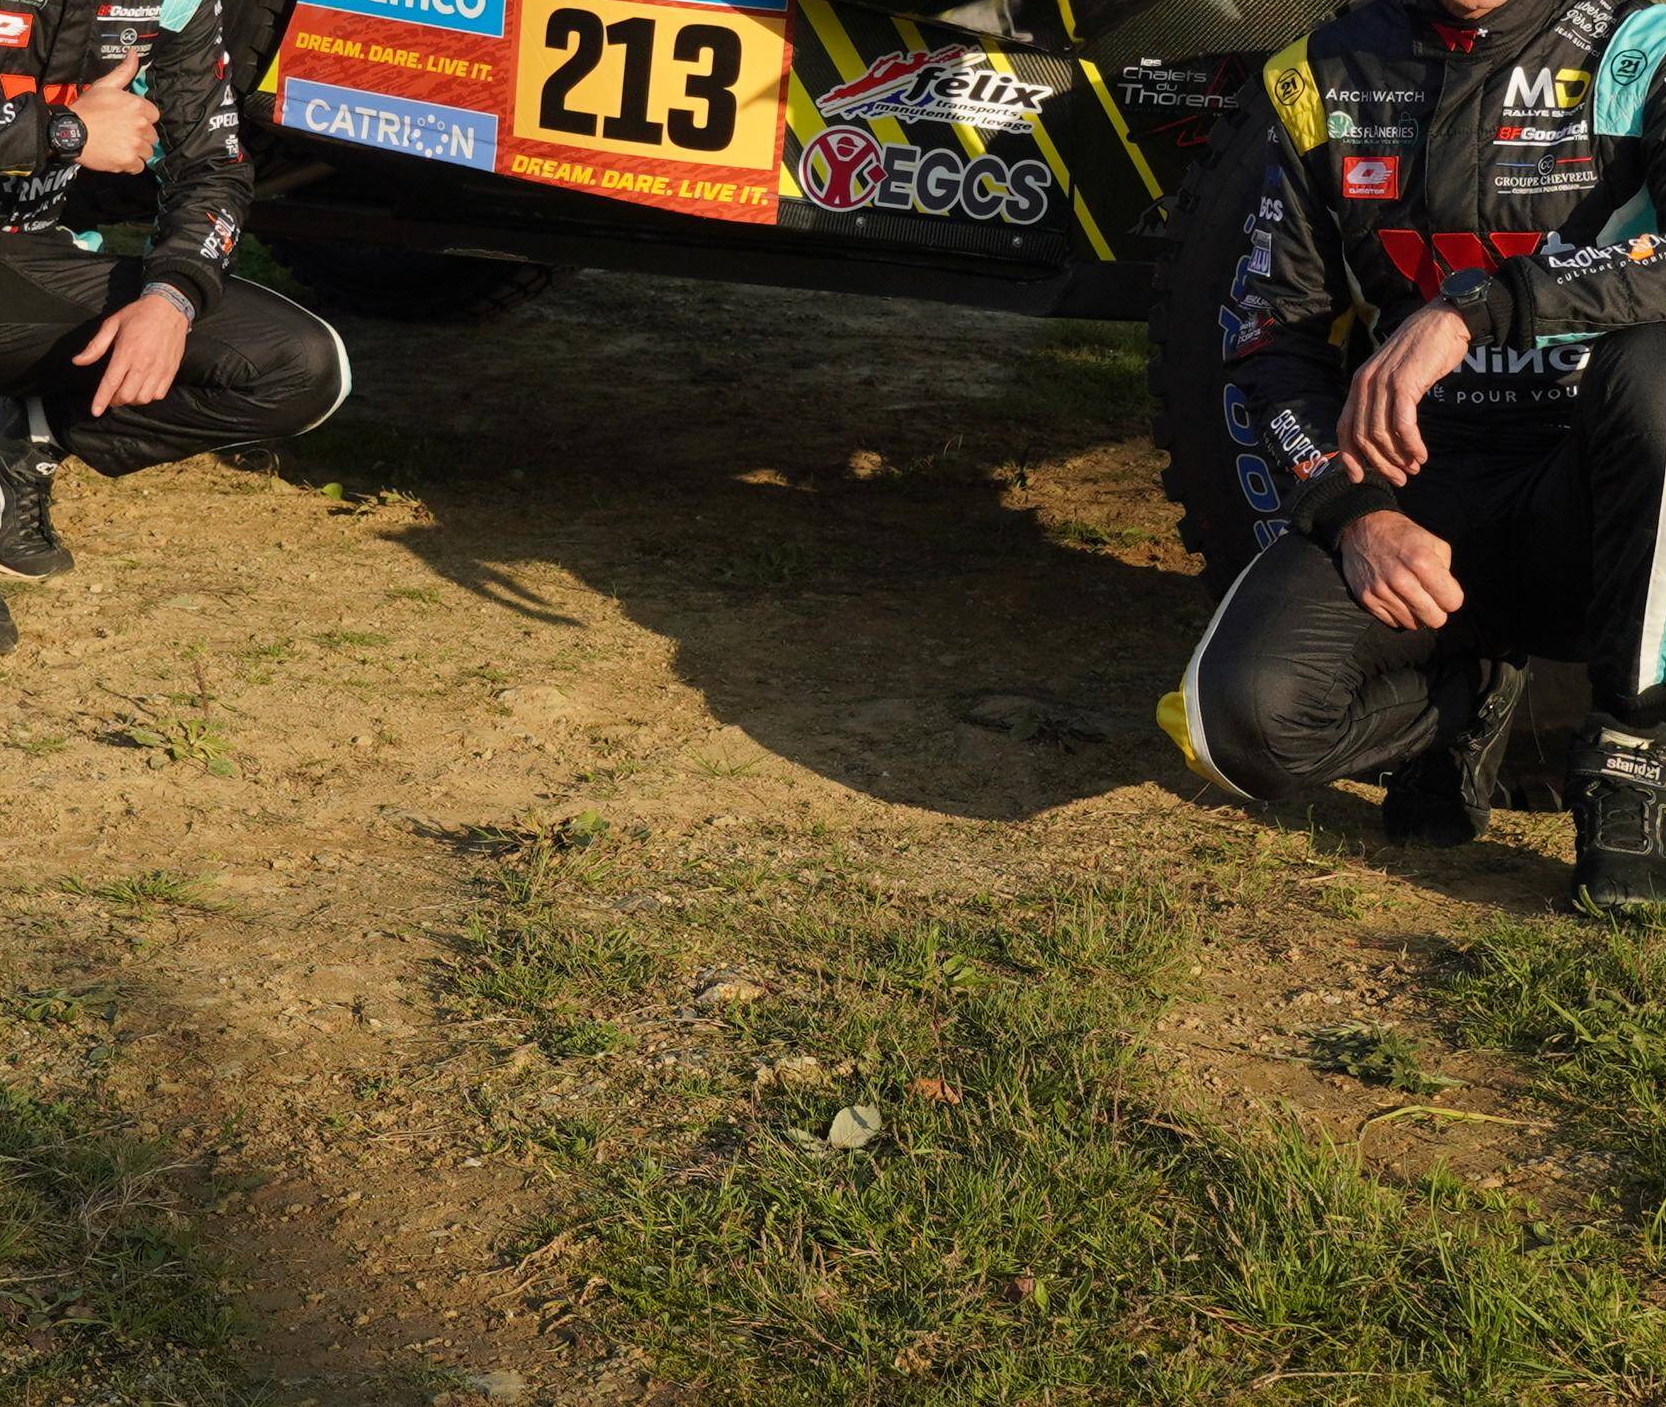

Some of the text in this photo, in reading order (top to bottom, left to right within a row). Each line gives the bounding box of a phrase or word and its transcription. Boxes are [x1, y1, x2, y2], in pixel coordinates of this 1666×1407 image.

[295, 32, 493, 82] DREAM. DARE. LIVE IT.
[538, 7, 743, 152] 213
[901, 66, 1051, 110] félix
[1122, 66, 1207, 83] Chalets
[1155, 81, 1178, 92] du
[1502, 66, 1592, 109] MD
[934, 99, 1019, 119] transports
[1116, 82, 1240, 109] Thorens
[1324, 88, 1425, 103] ARCHIWATCH
[873, 102, 1034, 132] manutention levage
[1496, 119, 1589, 141] BFGoodrich
[511, 154, 769, 207] DREAM. DARE. LIVE IT.
[877, 145, 1052, 226] EGCS
[1494, 170, 1598, 188] GROUPE CHEVREUL
[1456, 389, 1518, 404] POUR
